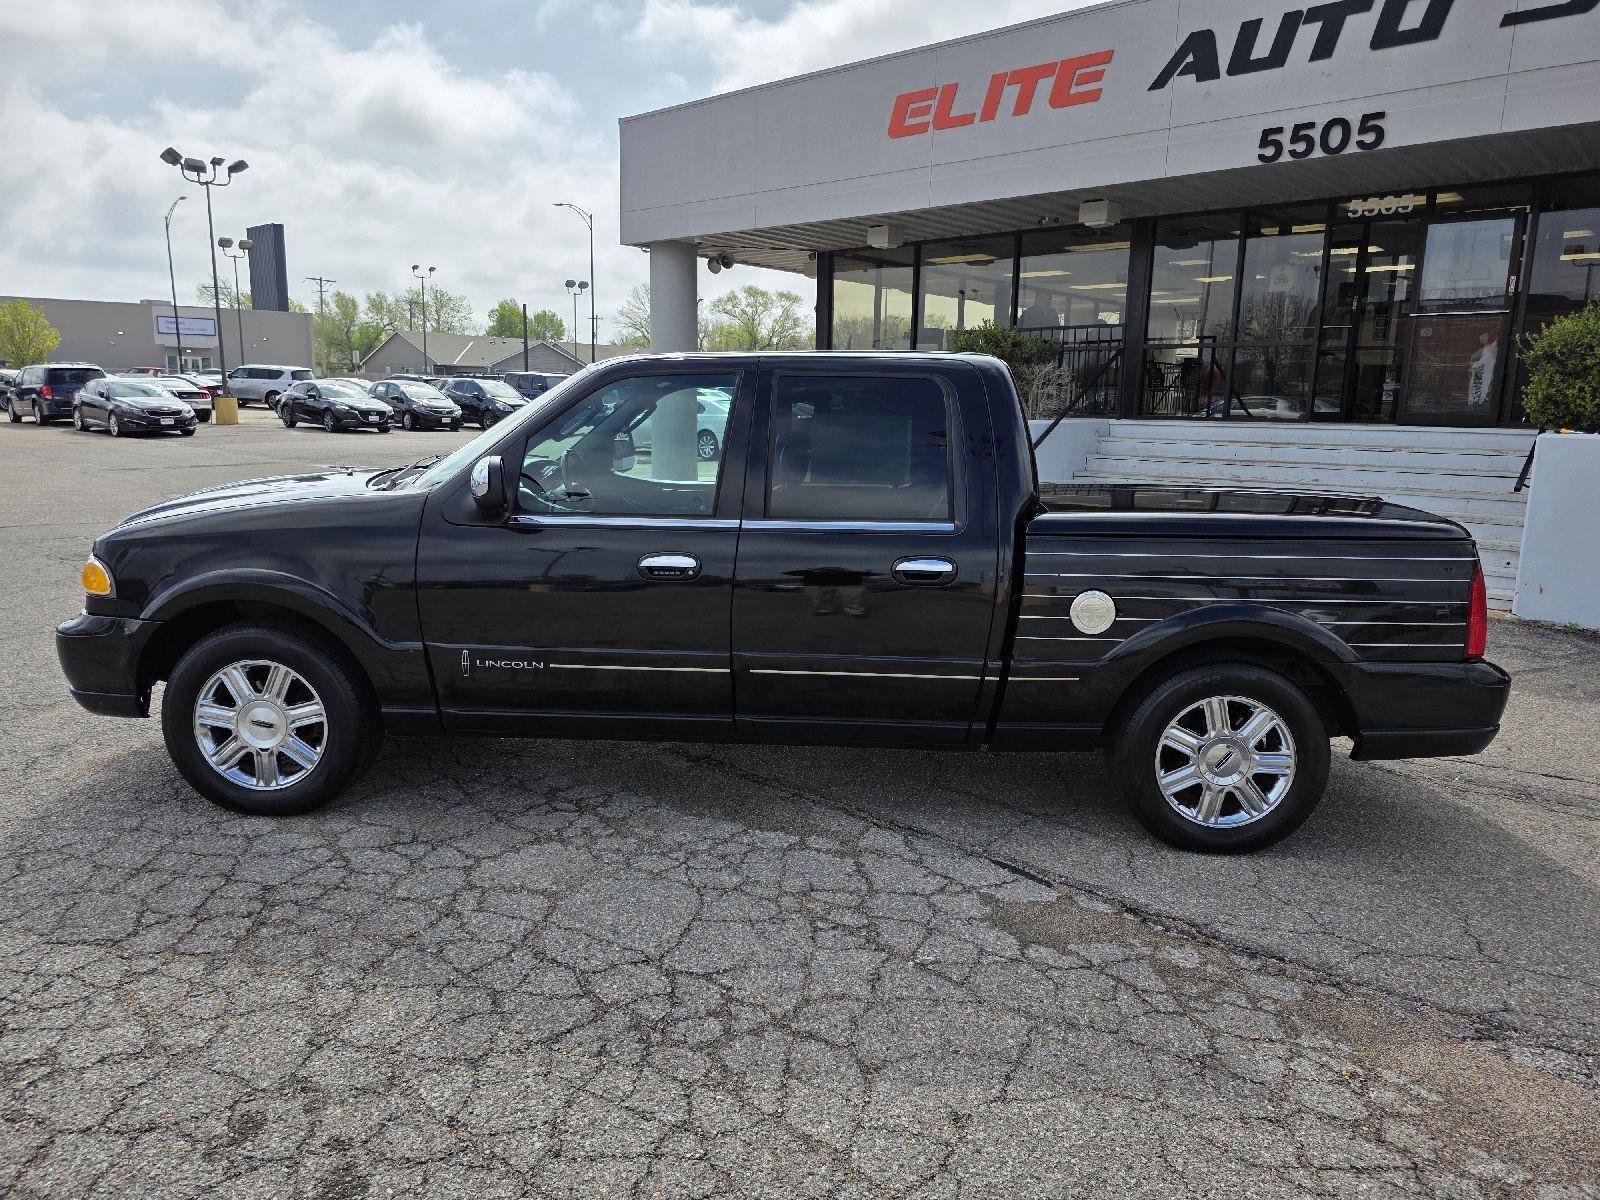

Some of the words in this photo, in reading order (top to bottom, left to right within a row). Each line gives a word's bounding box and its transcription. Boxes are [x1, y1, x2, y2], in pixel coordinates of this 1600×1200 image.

[888, 50, 1113, 139] ELITE
[1147, 0, 1454, 91] AUTO
[1257, 111, 1386, 165] 5505
[1347, 193, 1414, 218] 5505
[475, 658, 544, 670] LINCOLN
